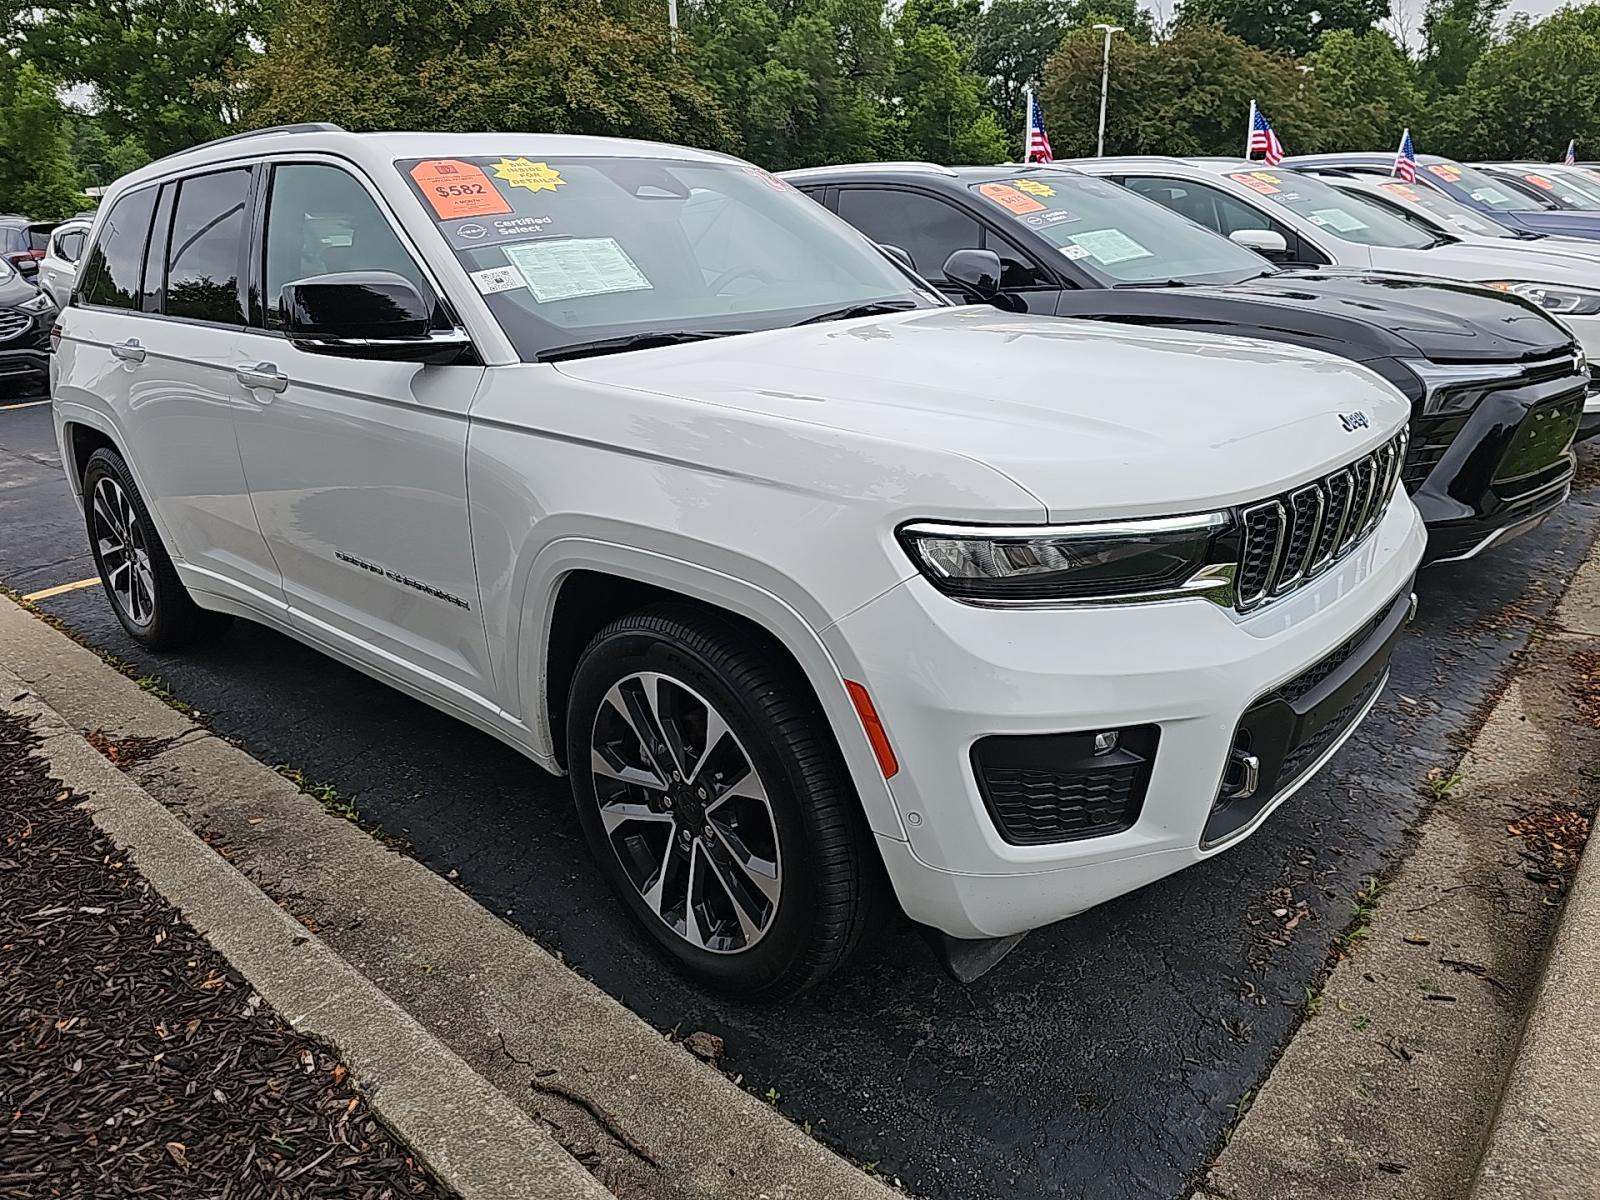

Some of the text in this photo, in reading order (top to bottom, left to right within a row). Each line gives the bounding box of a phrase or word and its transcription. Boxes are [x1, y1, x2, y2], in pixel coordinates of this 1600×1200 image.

[435, 183, 487, 198] $582
[493, 216, 553, 228] Certified
[498, 225, 543, 236] Select
[1338, 411, 1369, 432] Jeep
